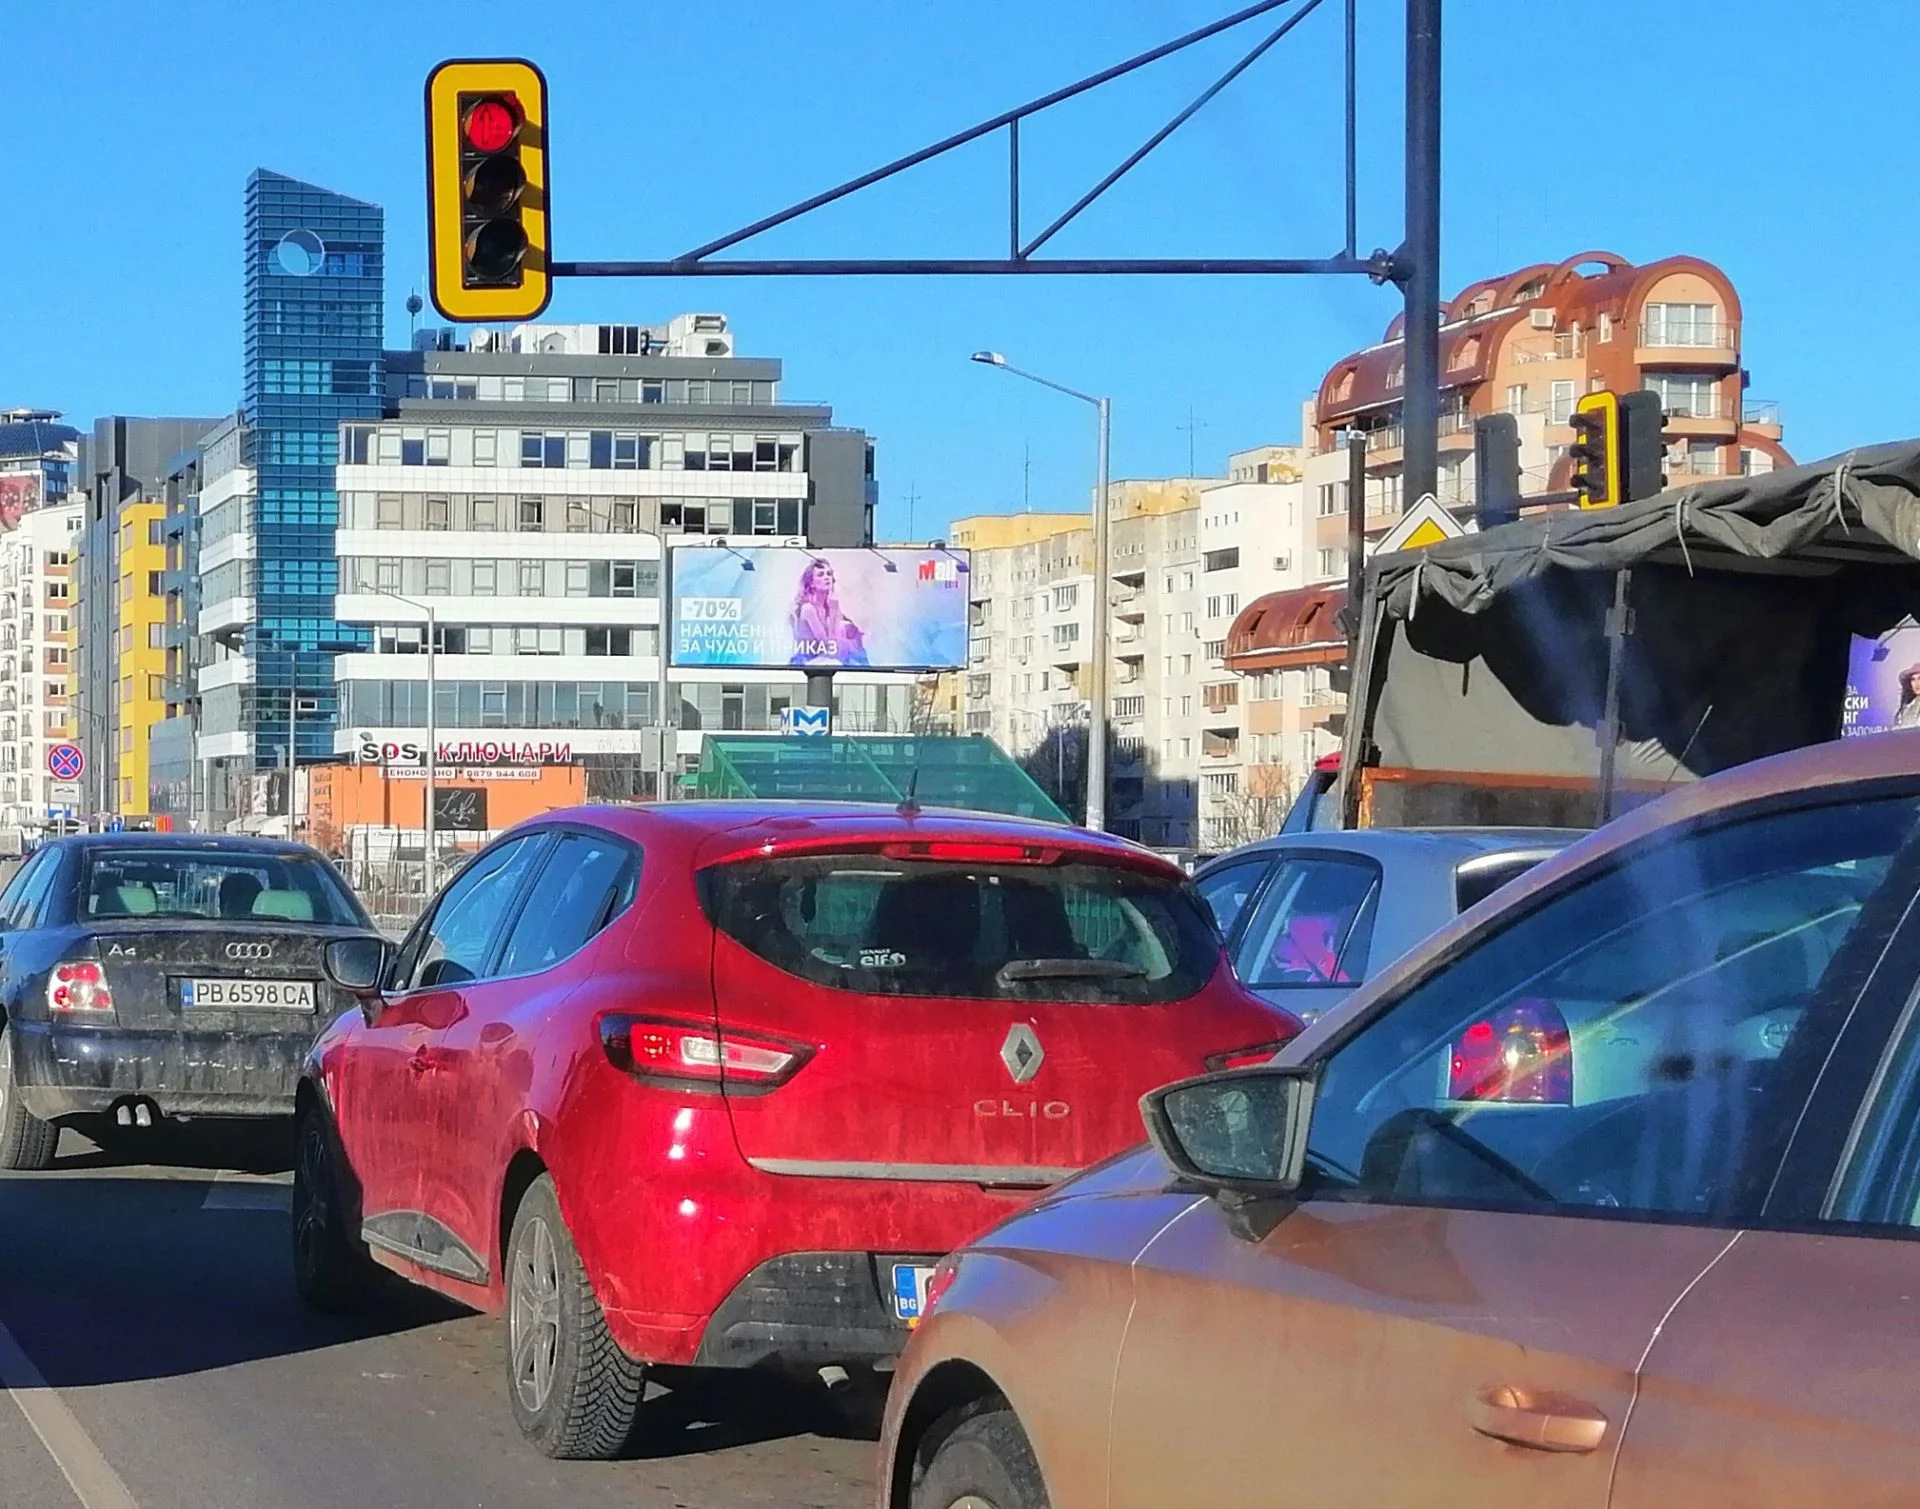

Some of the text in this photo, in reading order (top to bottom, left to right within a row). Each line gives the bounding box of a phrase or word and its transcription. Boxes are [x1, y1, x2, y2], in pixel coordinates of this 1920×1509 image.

[686, 600, 738, 618] -70%
[681, 639, 838, 655] ЗА ЧУДО И ПРИКАЗ
[361, 742, 572, 763] SOS КЛЮЧАРИ
[108, 944, 136, 957] A4
[197, 983, 310, 1006] PB 6598 CA
[973, 1099, 1071, 1119] CLIO
[899, 1297, 917, 1310] BG
